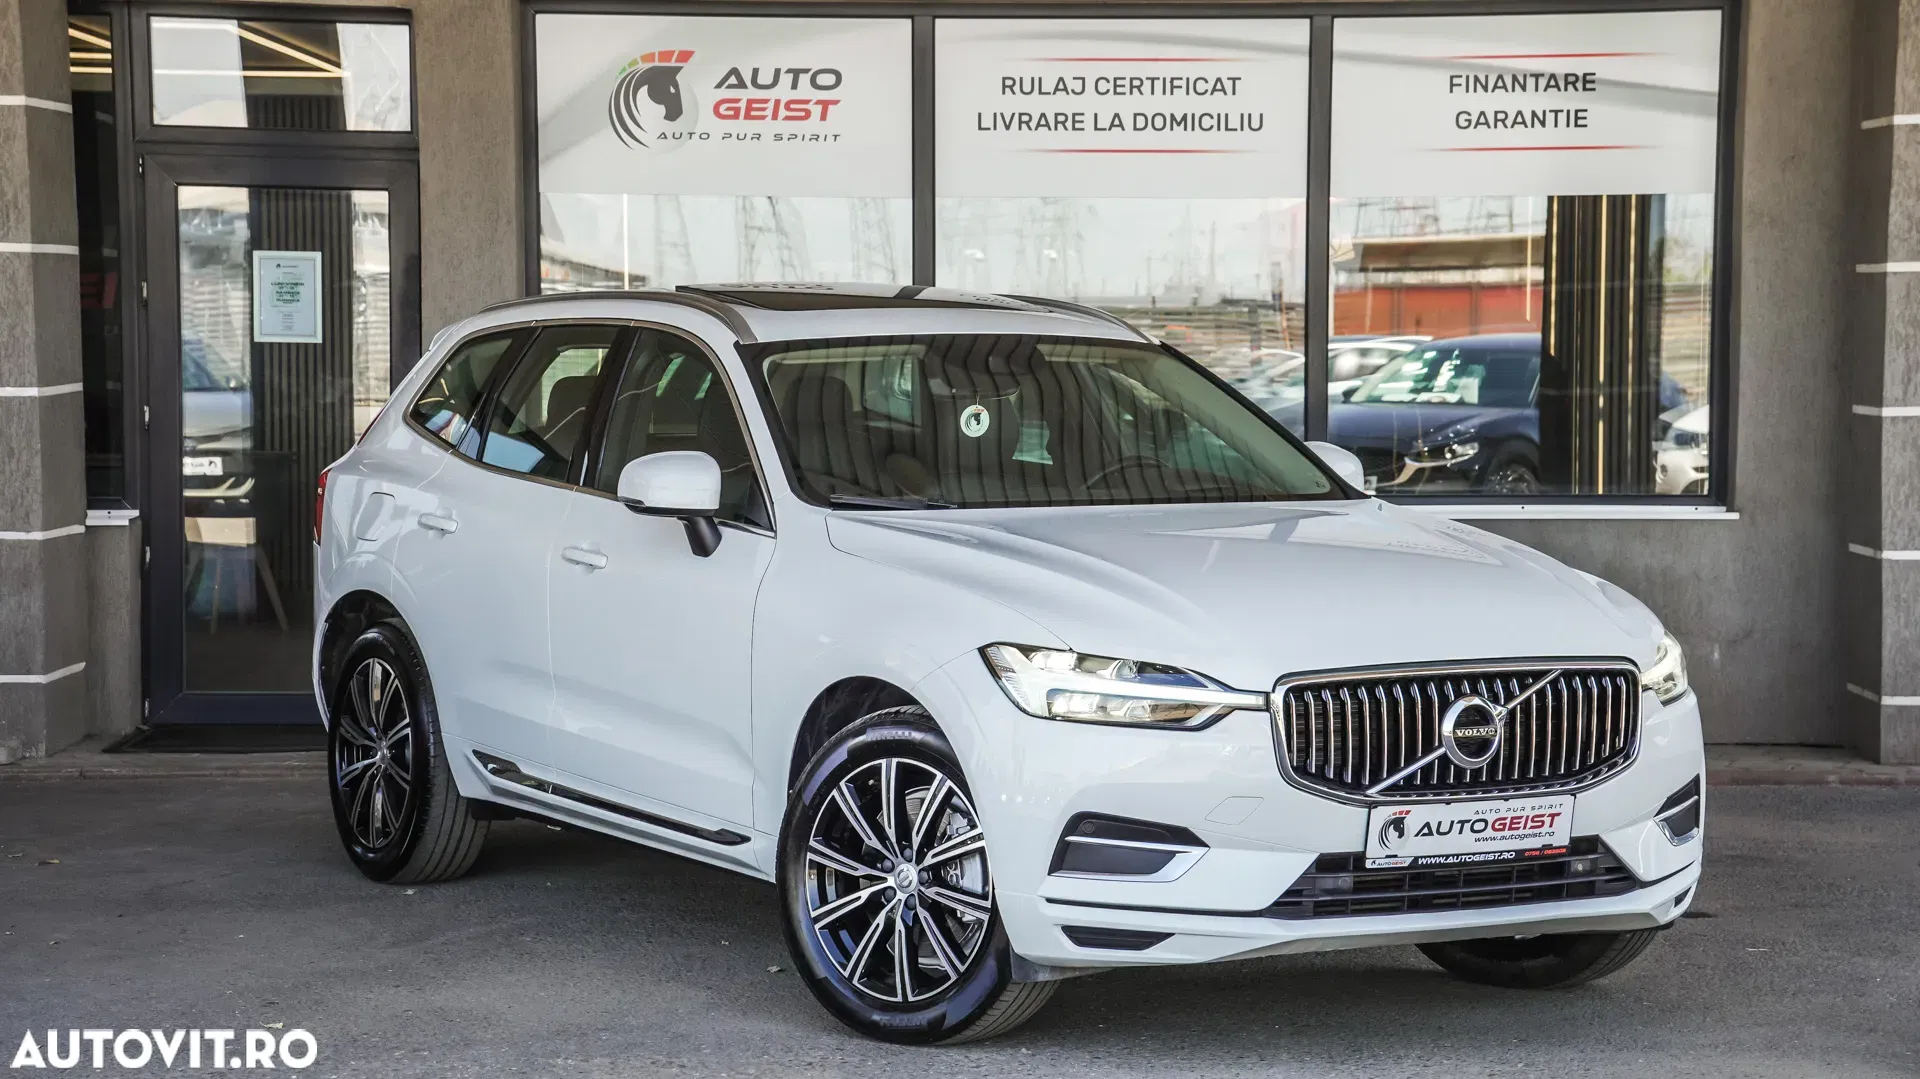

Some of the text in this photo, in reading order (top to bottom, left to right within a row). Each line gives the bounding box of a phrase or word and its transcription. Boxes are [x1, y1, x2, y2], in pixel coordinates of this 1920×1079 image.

[713, 66, 843, 91] AUTO
[1001, 76, 1242, 96] RULAJ CERTIFICAT
[1449, 72, 1597, 94] FINANTARE
[712, 98, 842, 122] GEIST
[1455, 108, 1589, 130] GARANTIE
[977, 112, 1264, 132] LIVRARE LA DOMICILIU
[656, 131, 842, 143] AUTO PUR SPIRIT
[1455, 727, 1496, 737] VOLVO
[1473, 808, 1501, 816] AUTO
[1530, 803, 1564, 811] SPIRIT
[1474, 831, 1555, 843] www.autogeist.ro
[1418, 851, 1516, 865] WWW.AUTOGEIST.RO
